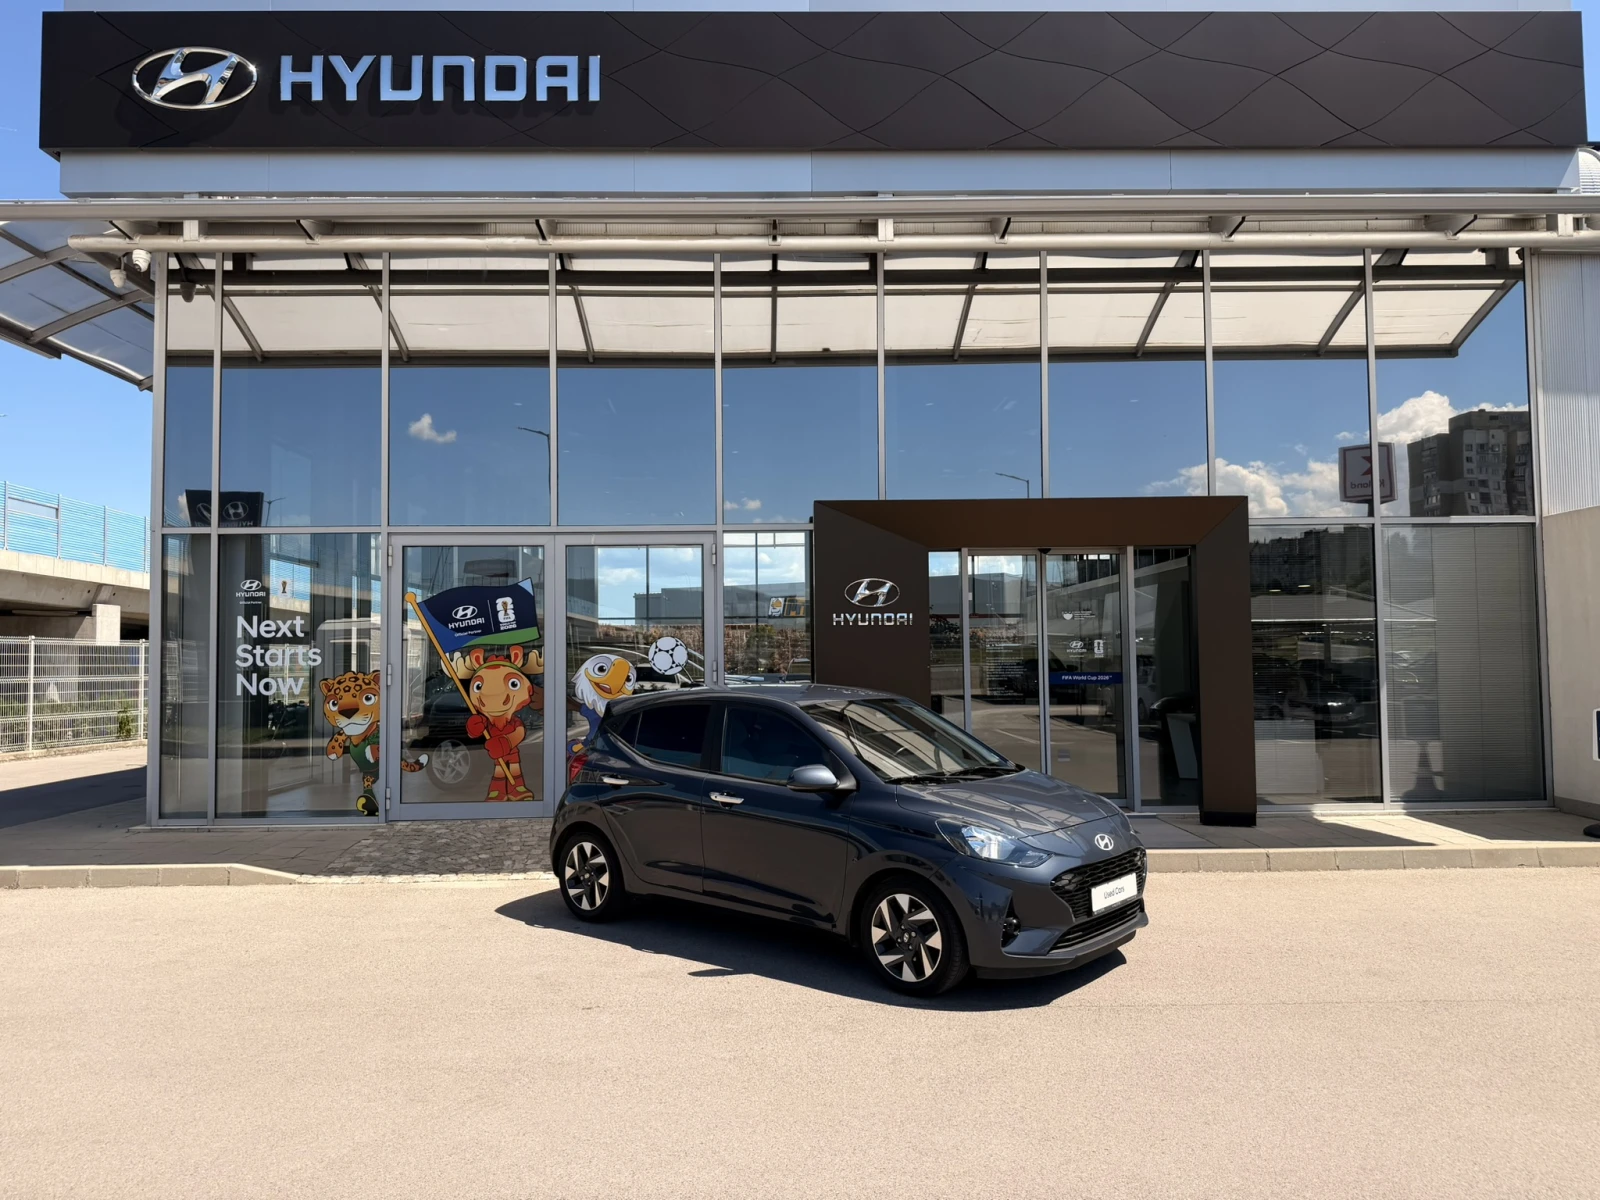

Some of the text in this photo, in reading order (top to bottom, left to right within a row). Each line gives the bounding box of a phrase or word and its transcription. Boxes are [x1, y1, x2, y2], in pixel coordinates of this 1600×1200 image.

[280, 55, 601, 102] HYUNDAI
[237, 615, 305, 638] Next
[448, 618, 485, 629] HYUNDAI
[832, 613, 913, 626] HYUNDAI
[235, 644, 322, 667] Starts
[236, 672, 305, 696] Now
